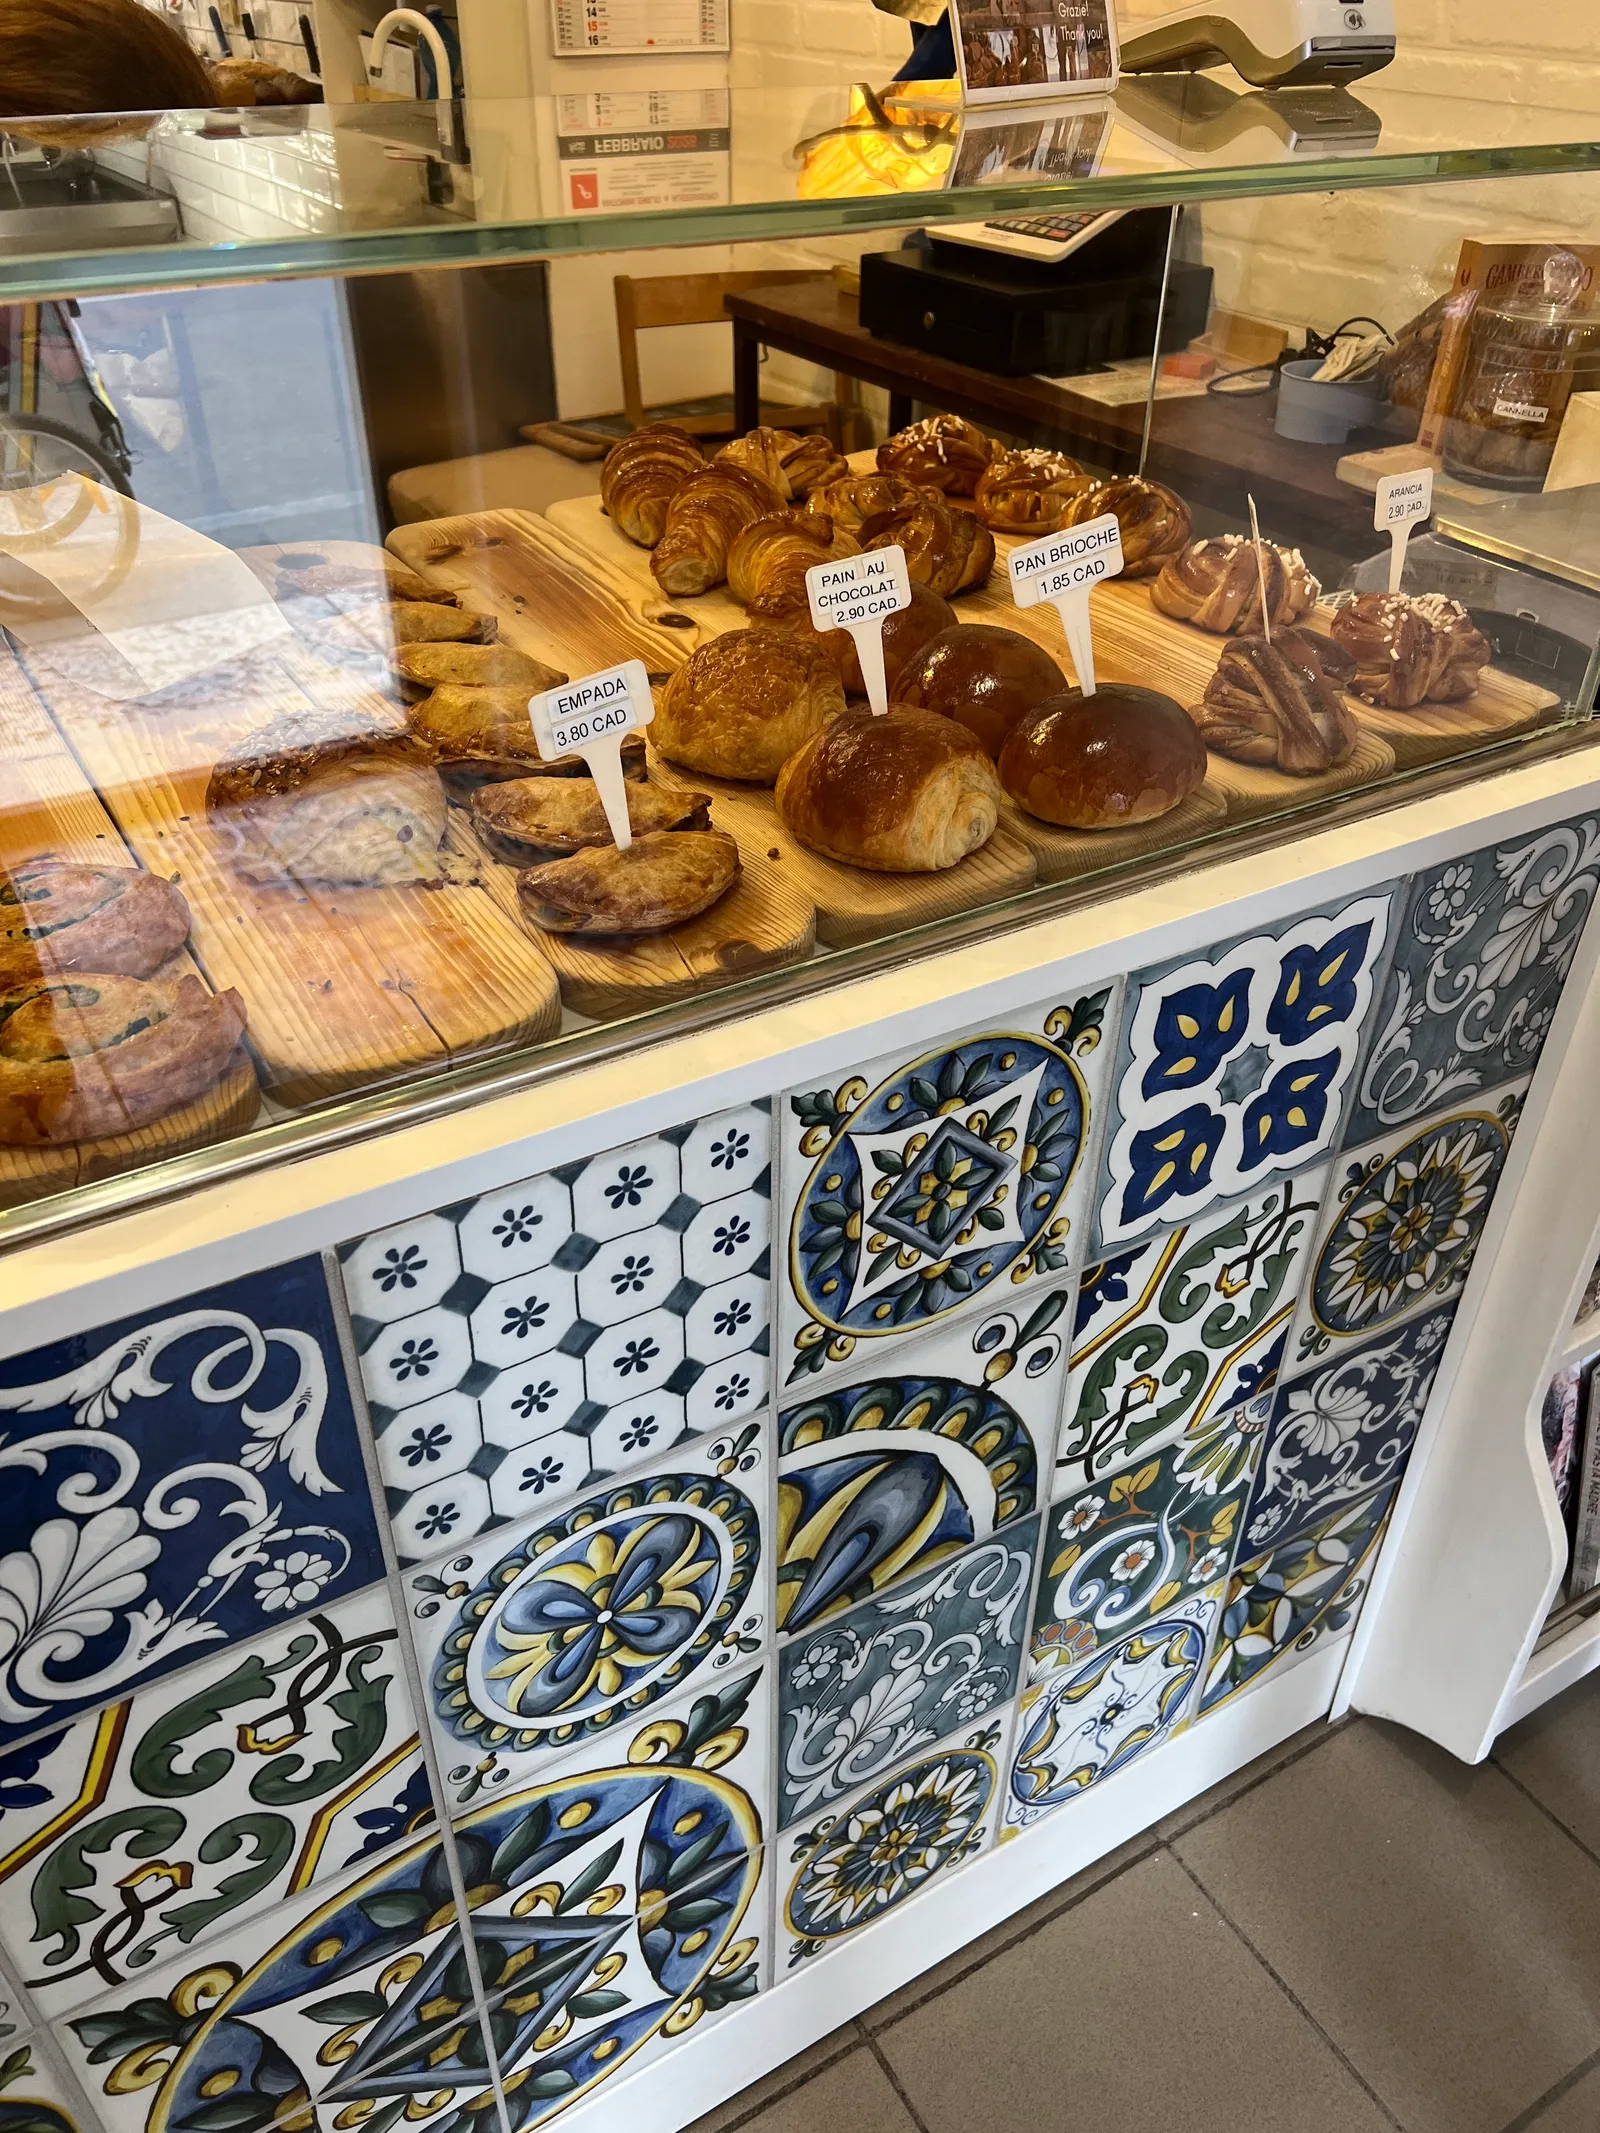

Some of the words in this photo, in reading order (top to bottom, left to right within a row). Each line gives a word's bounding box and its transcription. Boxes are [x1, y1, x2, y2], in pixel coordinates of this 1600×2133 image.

[586, 7, 597, 17] 14
[1058, 0, 1089, 17] Grazie!
[587, 20, 598, 32] 15
[1060, 24, 1085, 41] Thank
[1086, 23, 1104, 44] you!
[588, 35, 599, 45] 16
[1497, 405, 1545, 419] CANNELLA
[1389, 484, 1422, 499] ARANCIA
[1388, 504, 1404, 519] 2.90
[1407, 500, 1424, 513] CAD.
[1015, 552, 1046, 575] PAN
[1050, 527, 1118, 562] BRIOCHE
[821, 570, 855, 587] PAIN
[867, 561, 885, 576] AU
[1041, 573, 1070, 594] 1.85
[1073, 560, 1105, 581] CAD
[818, 579, 895, 608] CHOCOLAT
[836, 605, 865, 622] 2.90
[868, 597, 901, 614] CAD.
[558, 678, 627, 714] EMPADA
[556, 723, 589, 746] 3.80
[592, 709, 627, 732] CAD
